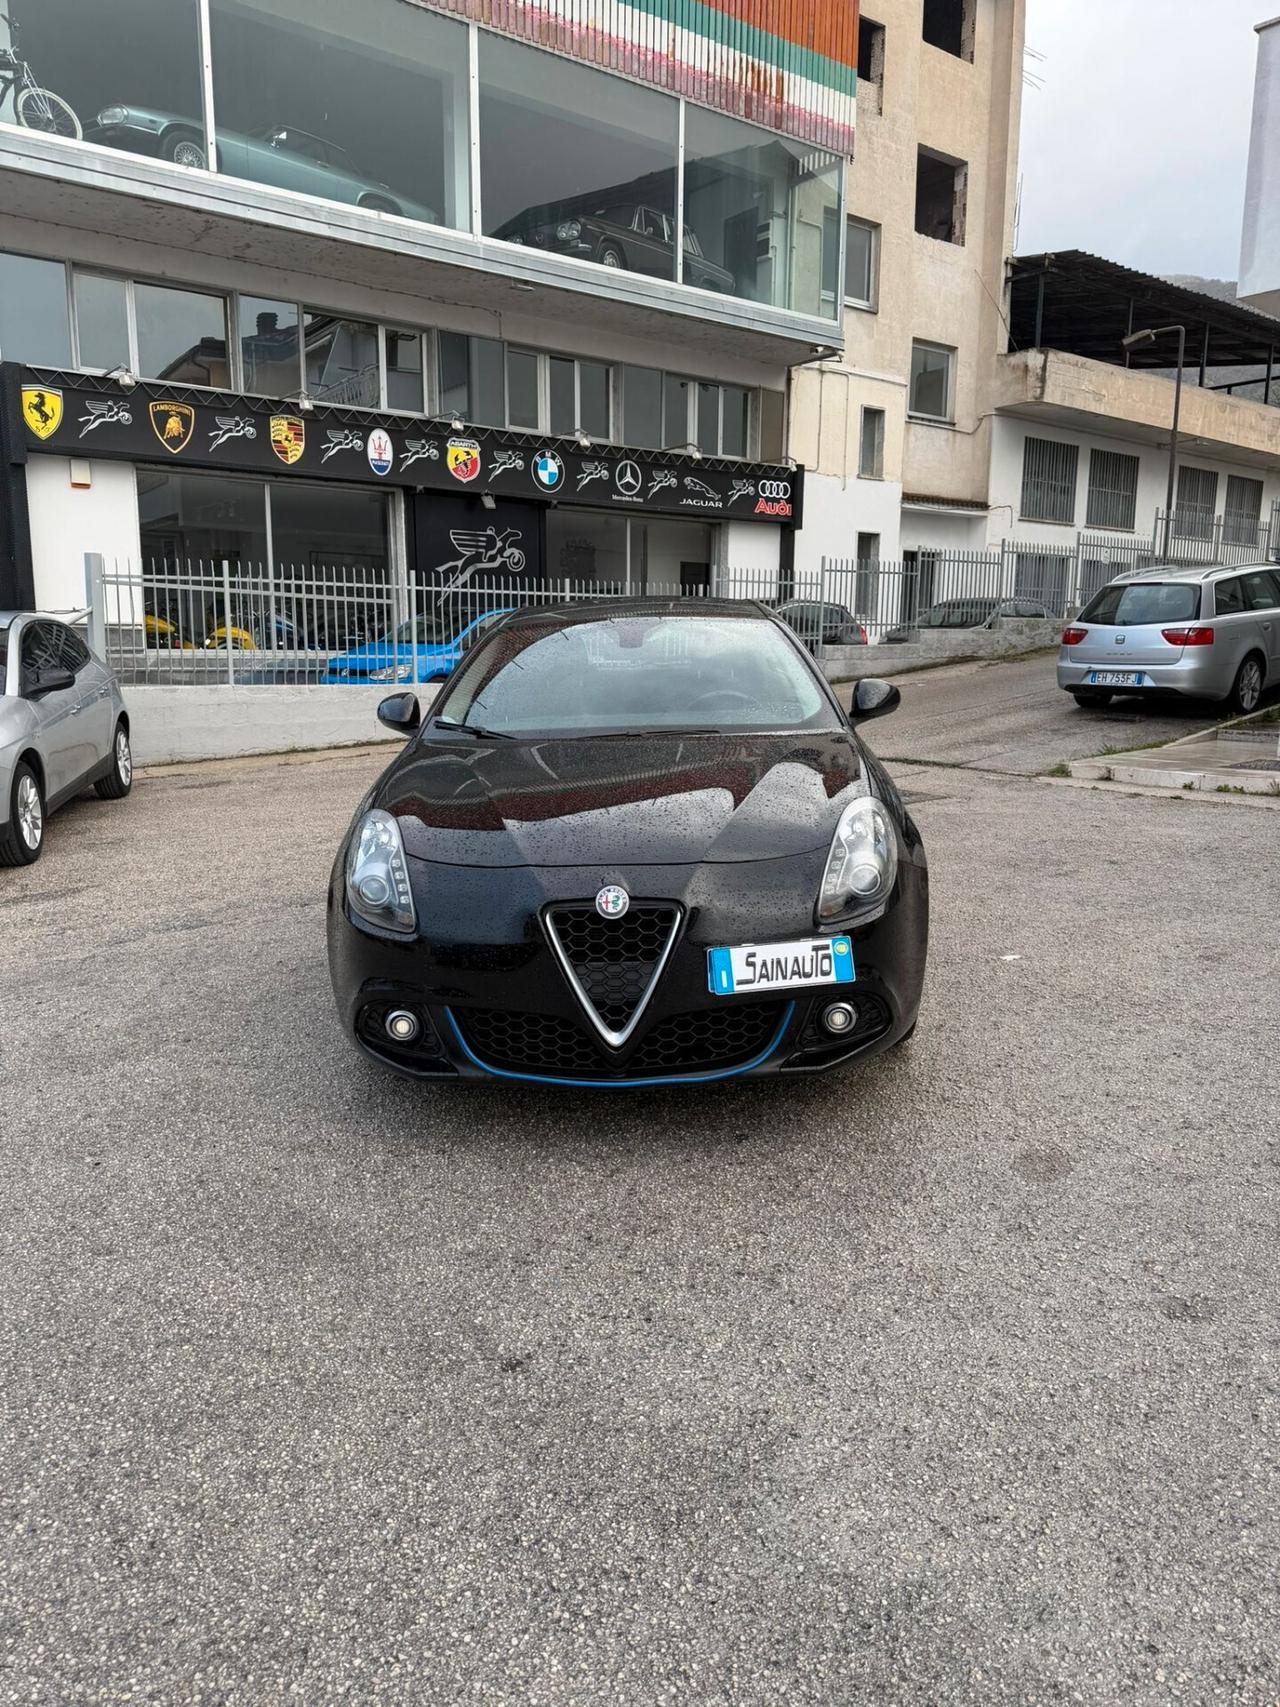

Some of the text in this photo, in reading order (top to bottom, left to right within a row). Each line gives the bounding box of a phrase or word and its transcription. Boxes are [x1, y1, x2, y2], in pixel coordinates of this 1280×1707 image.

[535, 451, 562, 466] BMW
[680, 498, 723, 508] JAGUAR
[754, 498, 792, 516] Audi
